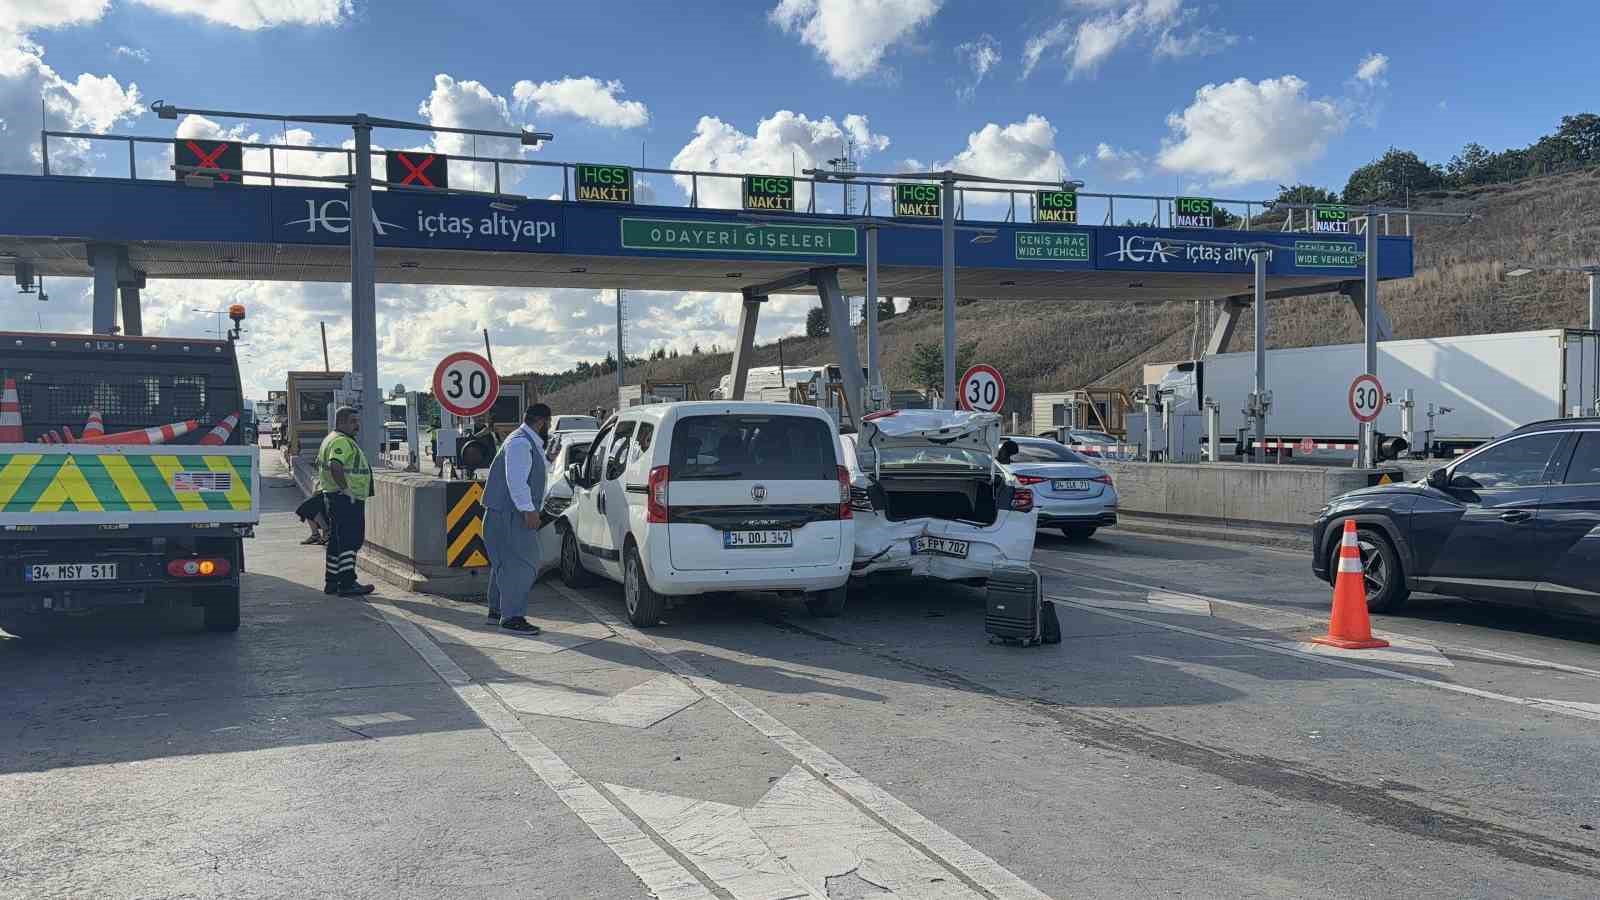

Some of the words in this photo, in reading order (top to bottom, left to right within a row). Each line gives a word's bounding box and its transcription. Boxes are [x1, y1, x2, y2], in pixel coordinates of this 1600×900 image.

[584, 167, 625, 185] HGS
[752, 177, 790, 194] HGS
[580, 186, 628, 202] NAKİT
[748, 194, 792, 209] NAKİT
[903, 187, 936, 202] HGS
[1042, 193, 1073, 208] HGS
[900, 201, 939, 217] NAKİT
[1181, 200, 1209, 213] HGS
[1039, 209, 1076, 224] NAKİT
[1178, 213, 1212, 227] NAKİT
[417, 209, 474, 239] içtaş
[479, 212, 556, 244] altyapı
[1316, 219, 1348, 232] NAKİT
[649, 228, 738, 245] ODAYERİ
[745, 230, 833, 249] GİŞELERİ
[1018, 247, 1043, 256] WIDE
[1046, 247, 1087, 257] VEHICLE
[1117, 235, 1169, 263] ICA
[1185, 243, 1222, 265] içtaş
[1297, 255, 1318, 264] WIDE
[1321, 255, 1355, 265] VEHICLE
[446, 369, 487, 399] 30
[968, 379, 996, 405] 30
[1355, 387, 1378, 410] 30
[731, 532, 744, 545] 34
[770, 530, 789, 544] 347
[928, 538, 945, 551] FPY
[948, 541, 966, 554] 702
[33, 566, 50, 580] 34
[58, 565, 82, 579] MSY
[90, 564, 116, 579] 511
